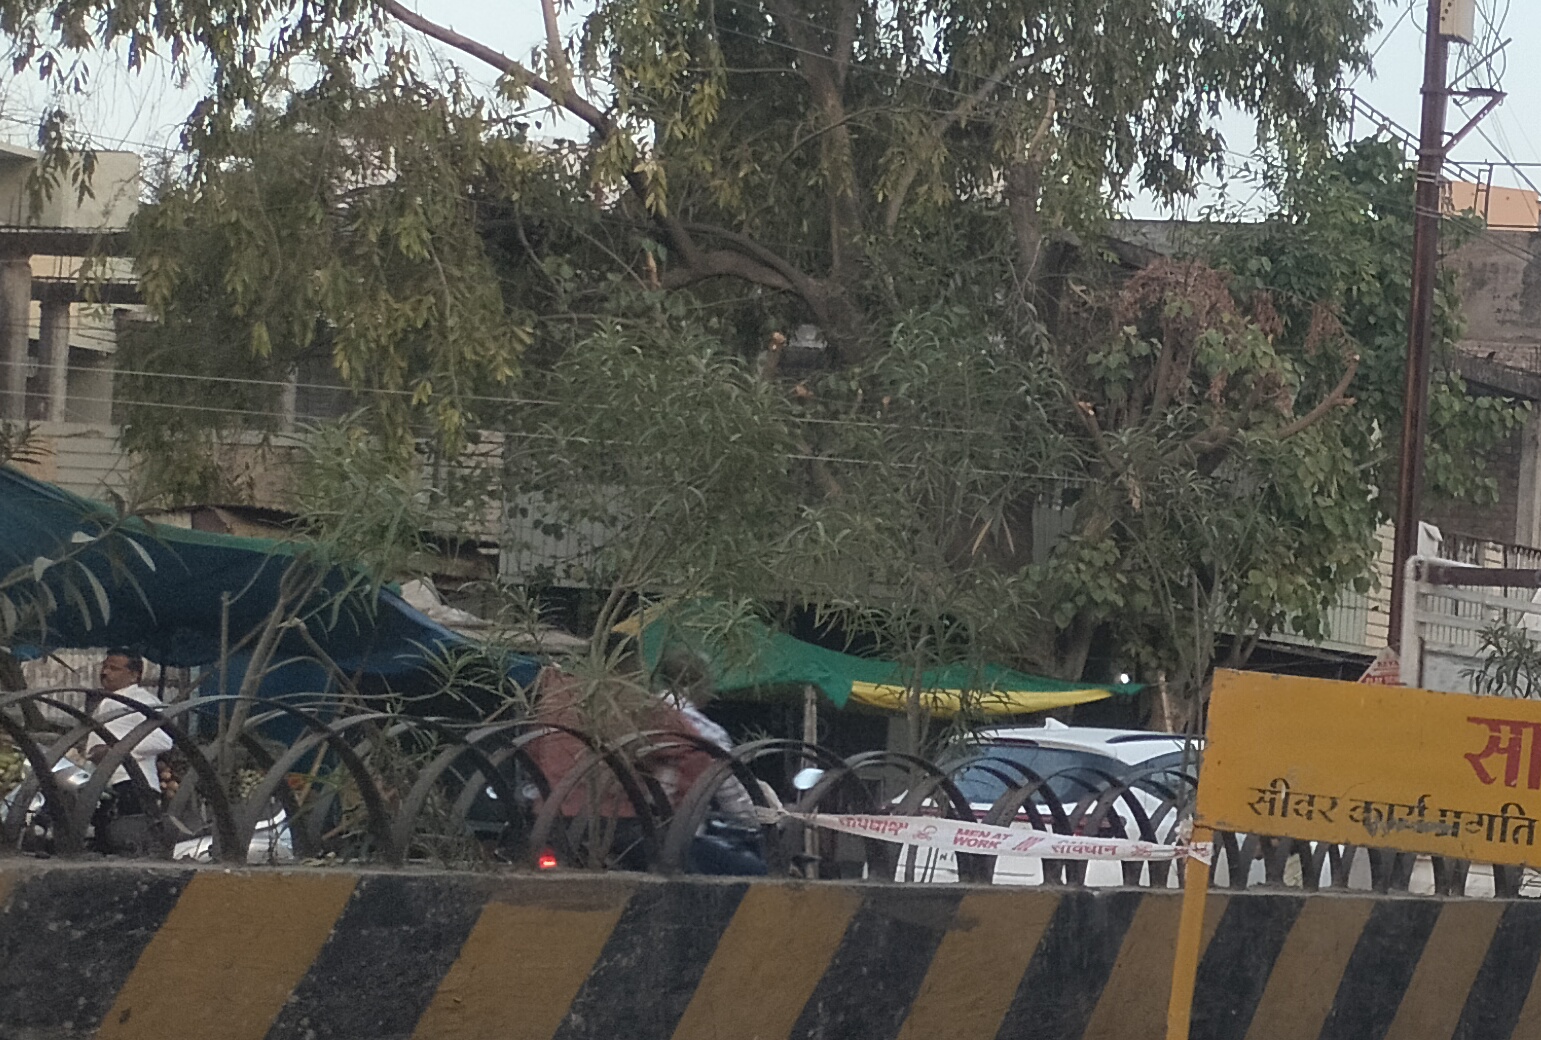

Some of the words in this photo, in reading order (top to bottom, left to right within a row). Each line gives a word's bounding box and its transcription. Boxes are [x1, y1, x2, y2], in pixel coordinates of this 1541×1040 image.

[1248, 778, 1338, 822] सीवर
[956, 828, 994, 838] MEN
[995, 833, 1013, 841] AT
[953, 835, 1002, 849] WORK
